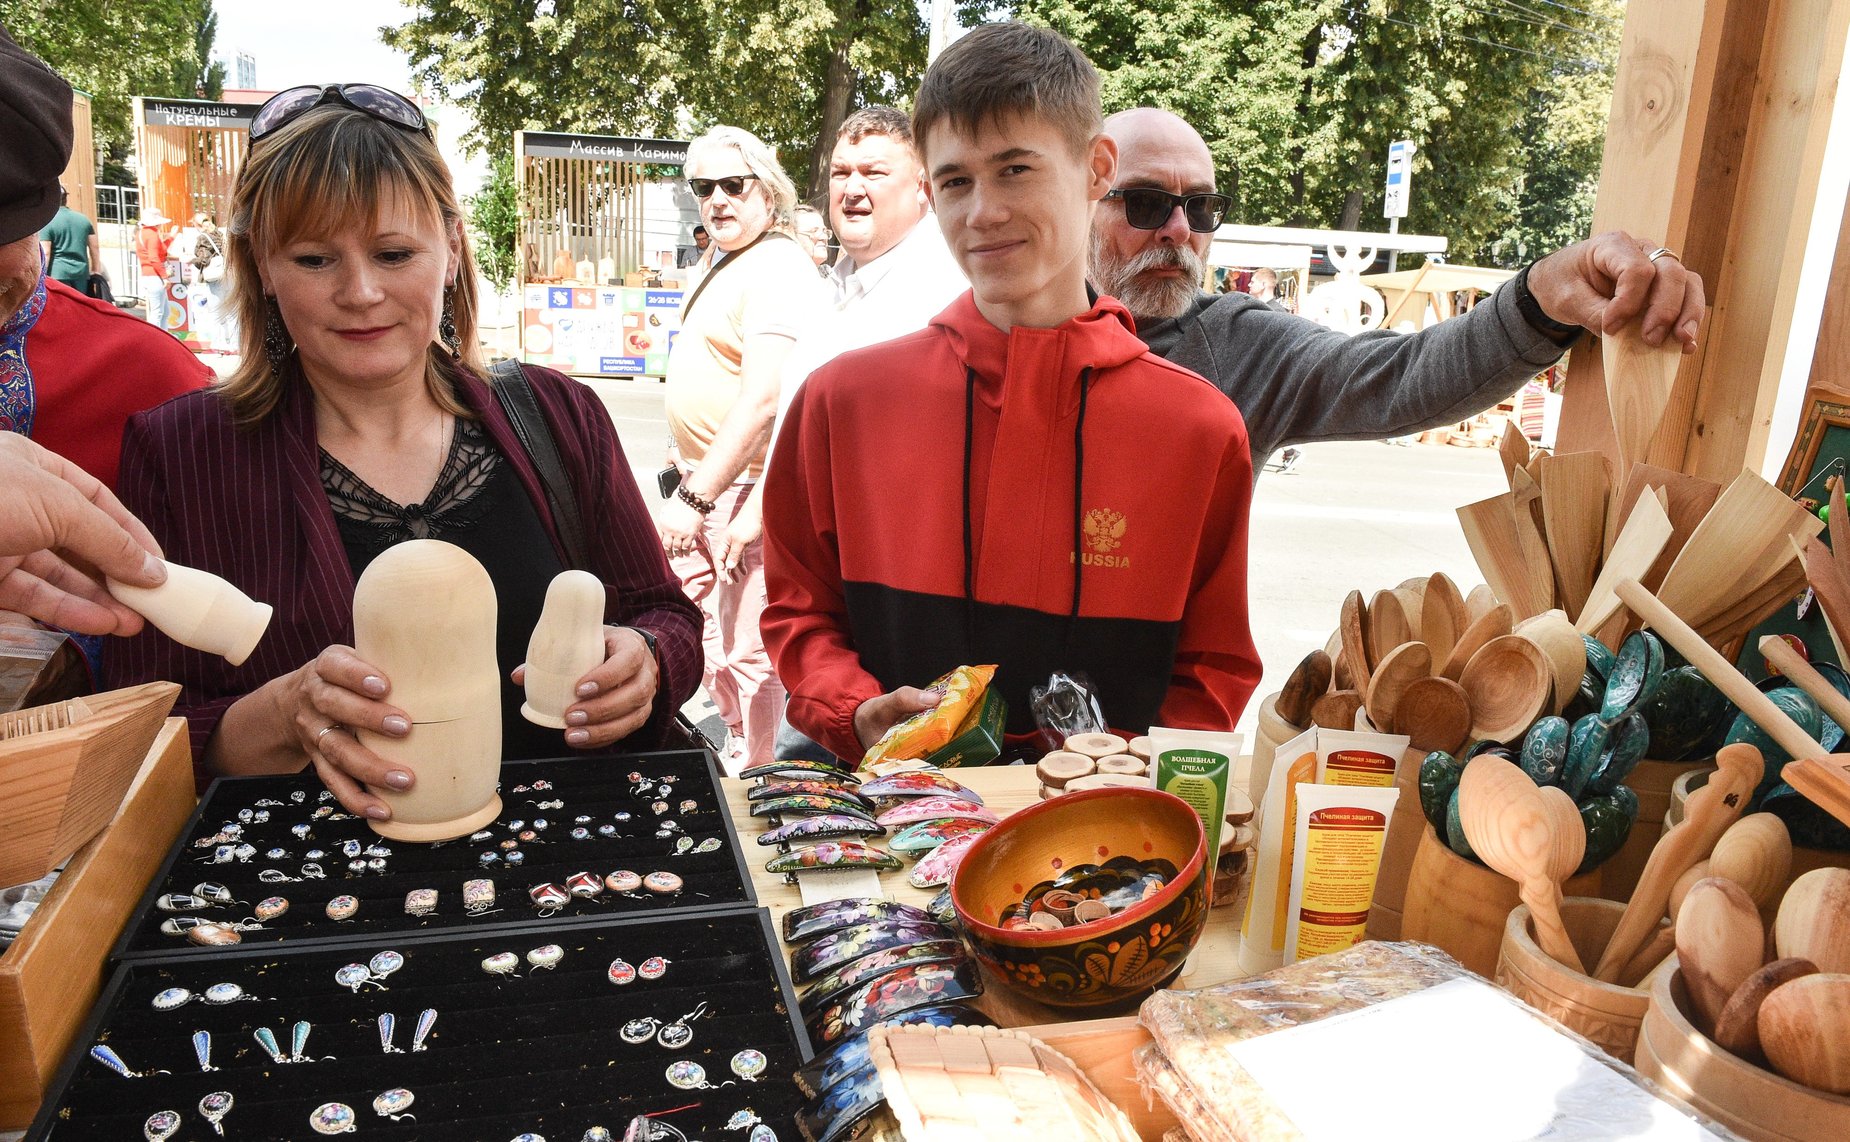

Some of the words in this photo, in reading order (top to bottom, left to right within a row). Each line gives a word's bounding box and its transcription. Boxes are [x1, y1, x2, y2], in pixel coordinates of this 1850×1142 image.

[155, 104, 238, 117] Натуральные
[166, 114, 220, 127] КРЕМЫ
[569, 140, 624, 158] Массив
[633, 142, 687, 161] Каримо
[1171, 755, 1217, 764] ВОЛШЕБНАЯ
[1336, 753, 1365, 763] Пчелиная
[1365, 757, 1386, 765] защита
[1319, 811, 1350, 822] Пчелиная
[1350, 813, 1375, 823] защита
